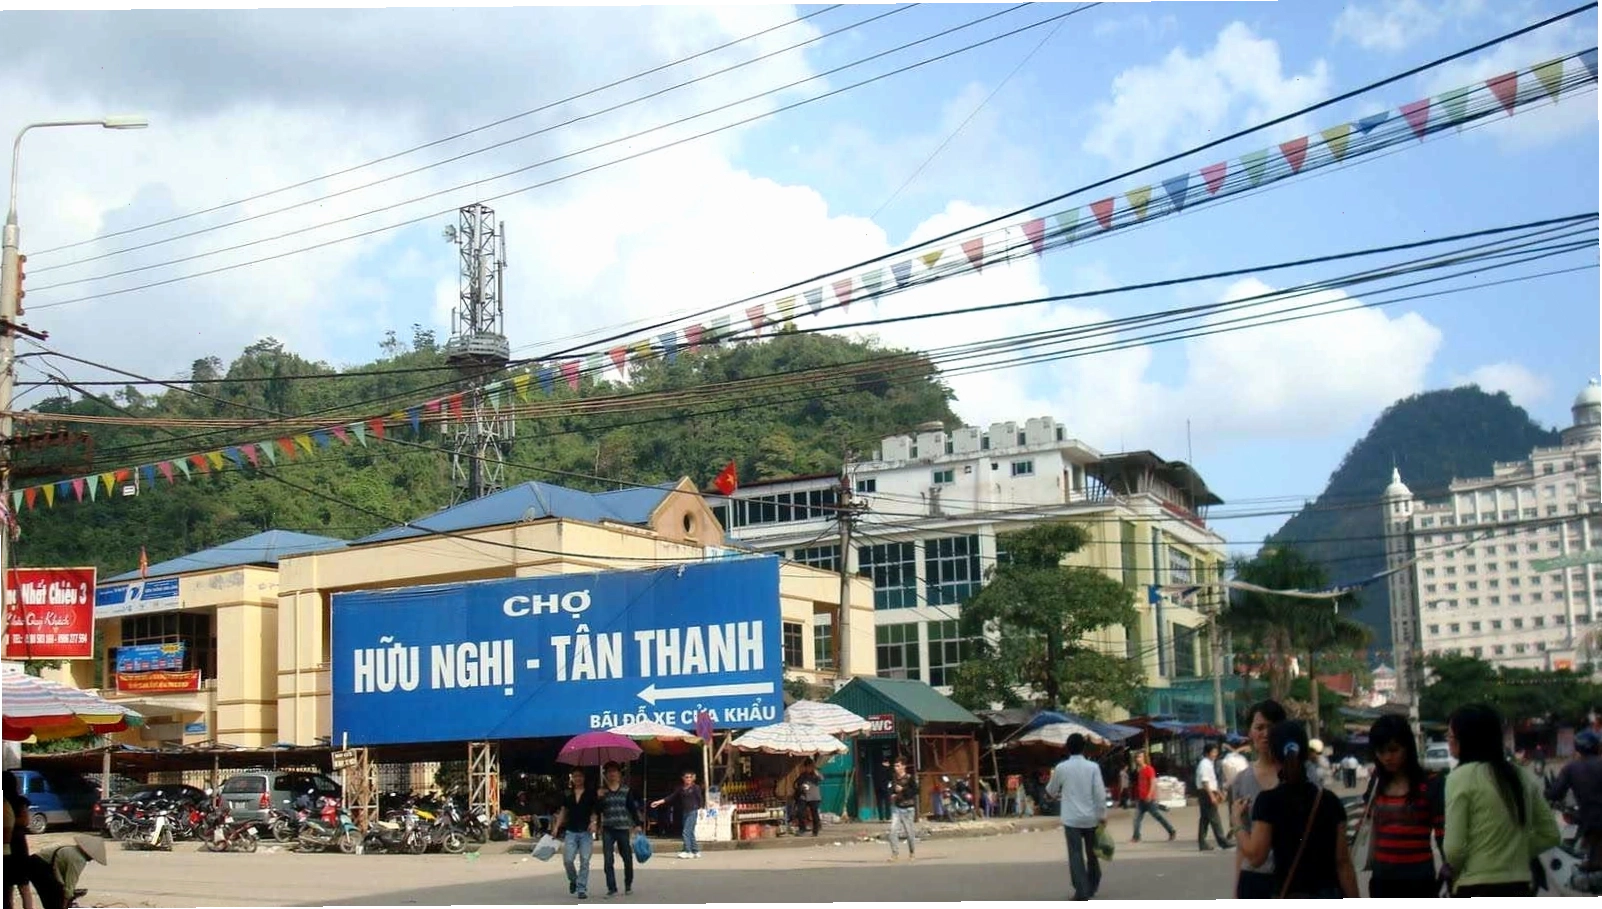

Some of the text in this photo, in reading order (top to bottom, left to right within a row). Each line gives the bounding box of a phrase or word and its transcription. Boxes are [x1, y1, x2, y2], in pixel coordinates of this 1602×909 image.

[503, 590, 591, 618] CHỢ
[354, 620, 764, 696] HỮU NGHỊ - TÂN THANH
[590, 710, 618, 728] BÃI
[653, 710, 676, 725] XE
[724, 697, 776, 723] KHẨU
[869, 719, 893, 732] WC
